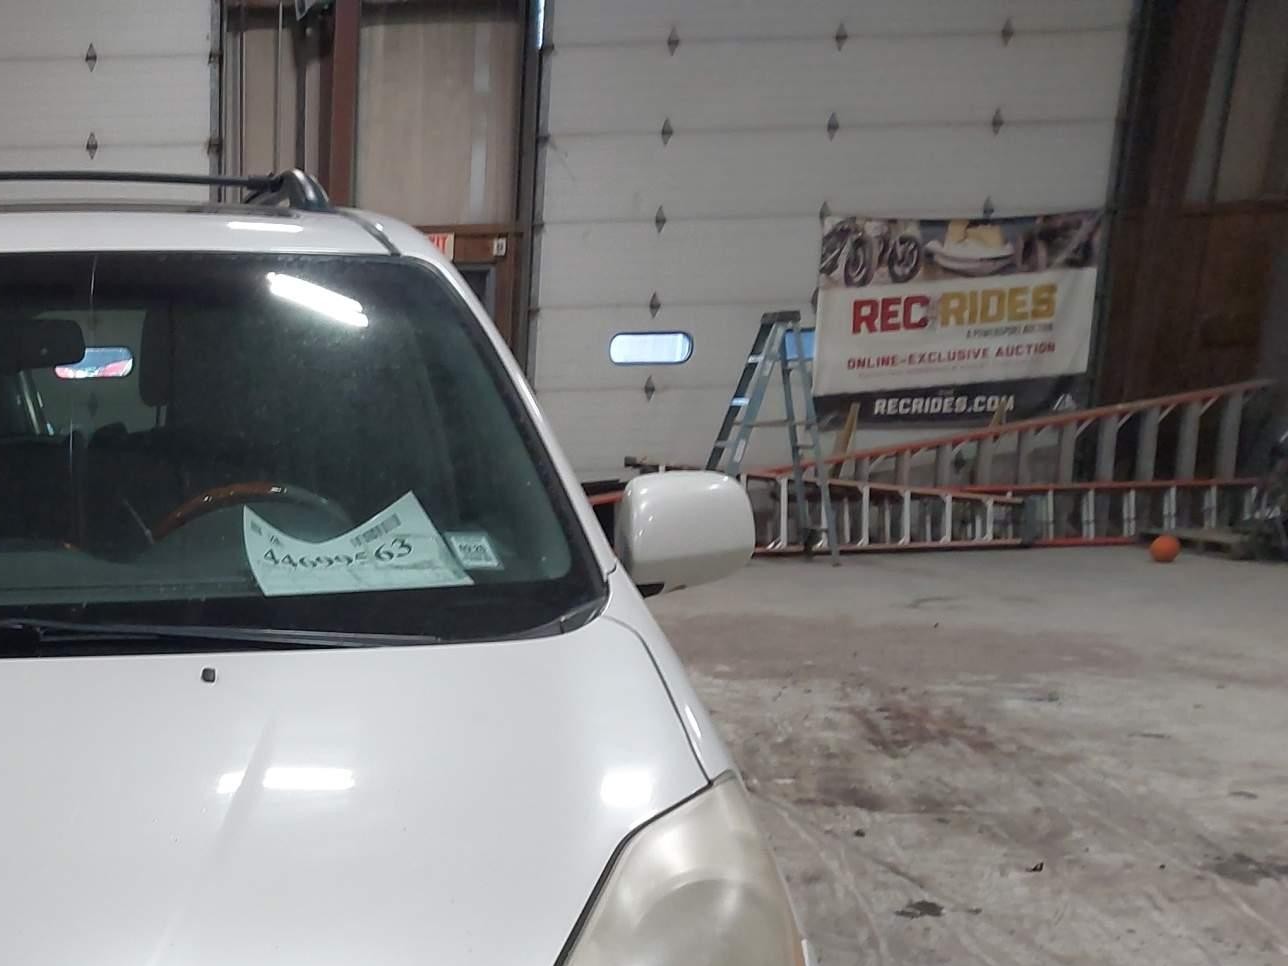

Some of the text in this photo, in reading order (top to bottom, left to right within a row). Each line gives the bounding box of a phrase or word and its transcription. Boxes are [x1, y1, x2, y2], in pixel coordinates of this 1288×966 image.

[852, 283, 1058, 335] REC RIDES
[847, 347, 989, 370] ONLINE-EXCLUSIVE
[995, 341, 1056, 358] AUCTION
[874, 394, 1015, 415] RECRIDES.COM
